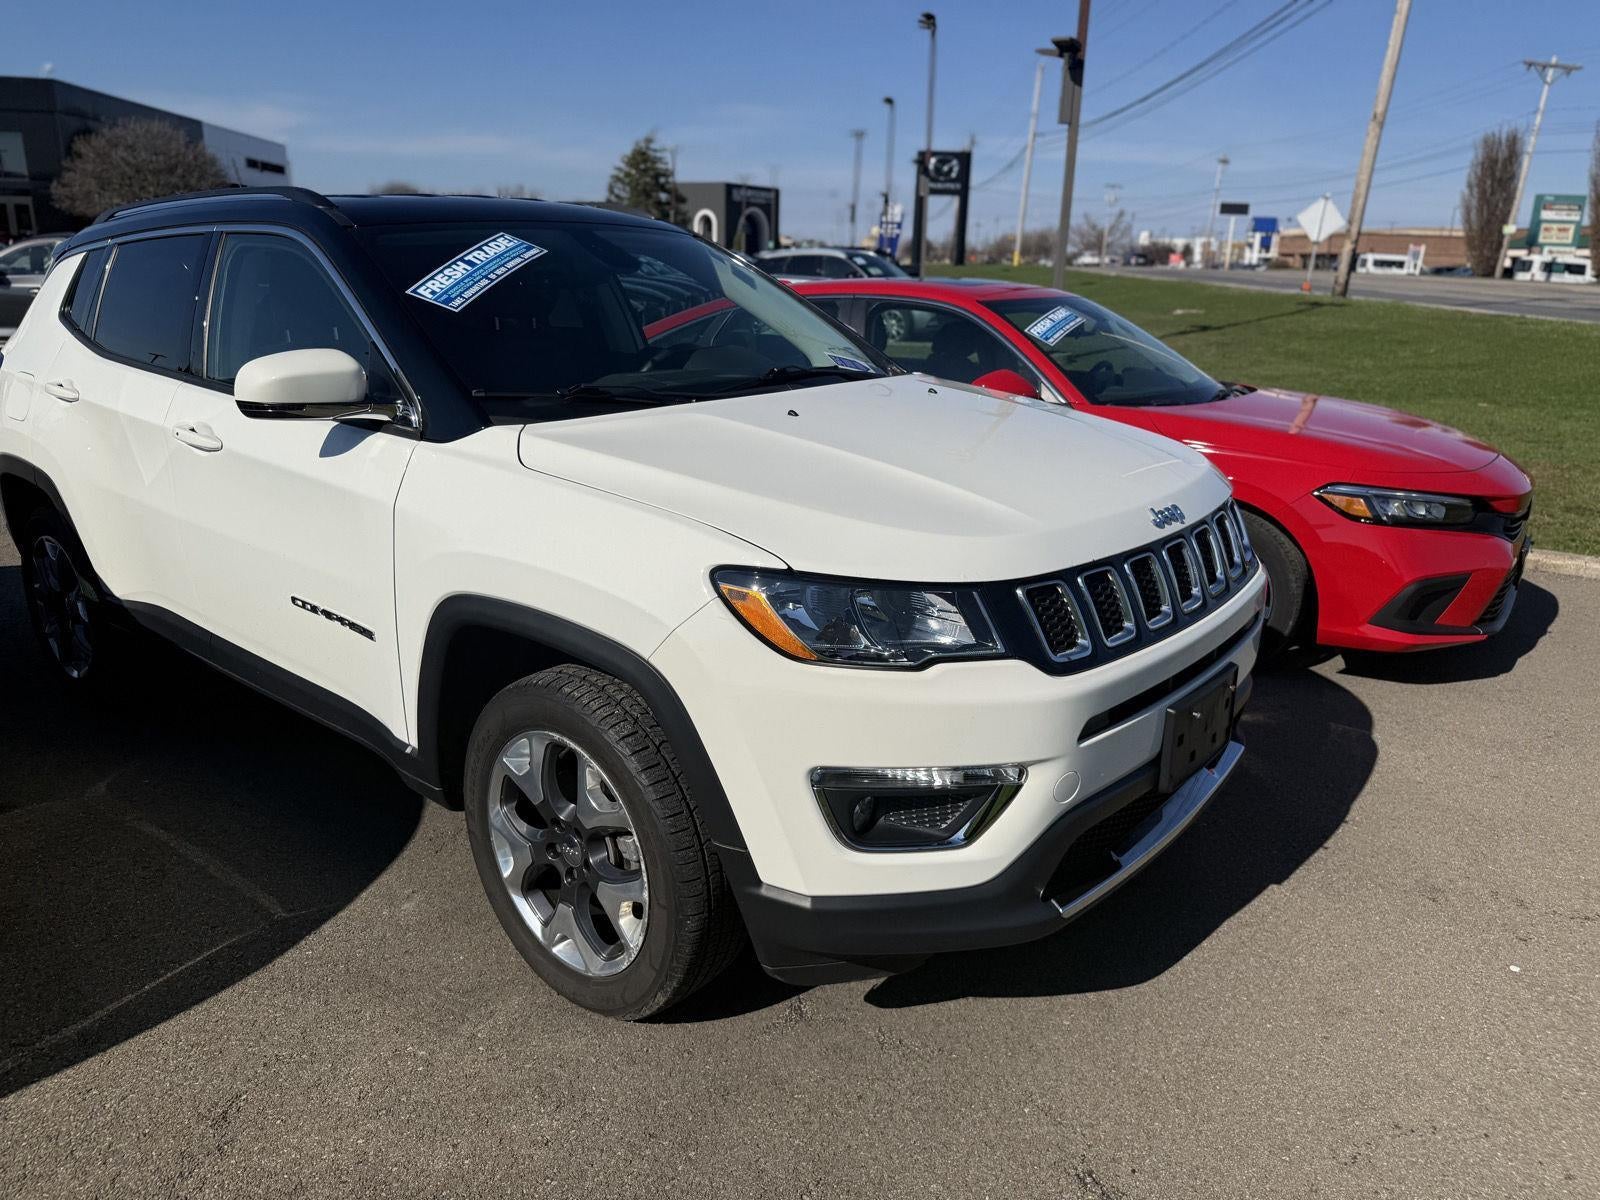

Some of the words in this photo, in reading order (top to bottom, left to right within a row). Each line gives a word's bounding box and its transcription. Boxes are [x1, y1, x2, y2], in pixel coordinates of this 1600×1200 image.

[416, 261, 474, 298] FRESH
[464, 235, 518, 265] TRADE!
[1150, 503, 1186, 529] Jeep
